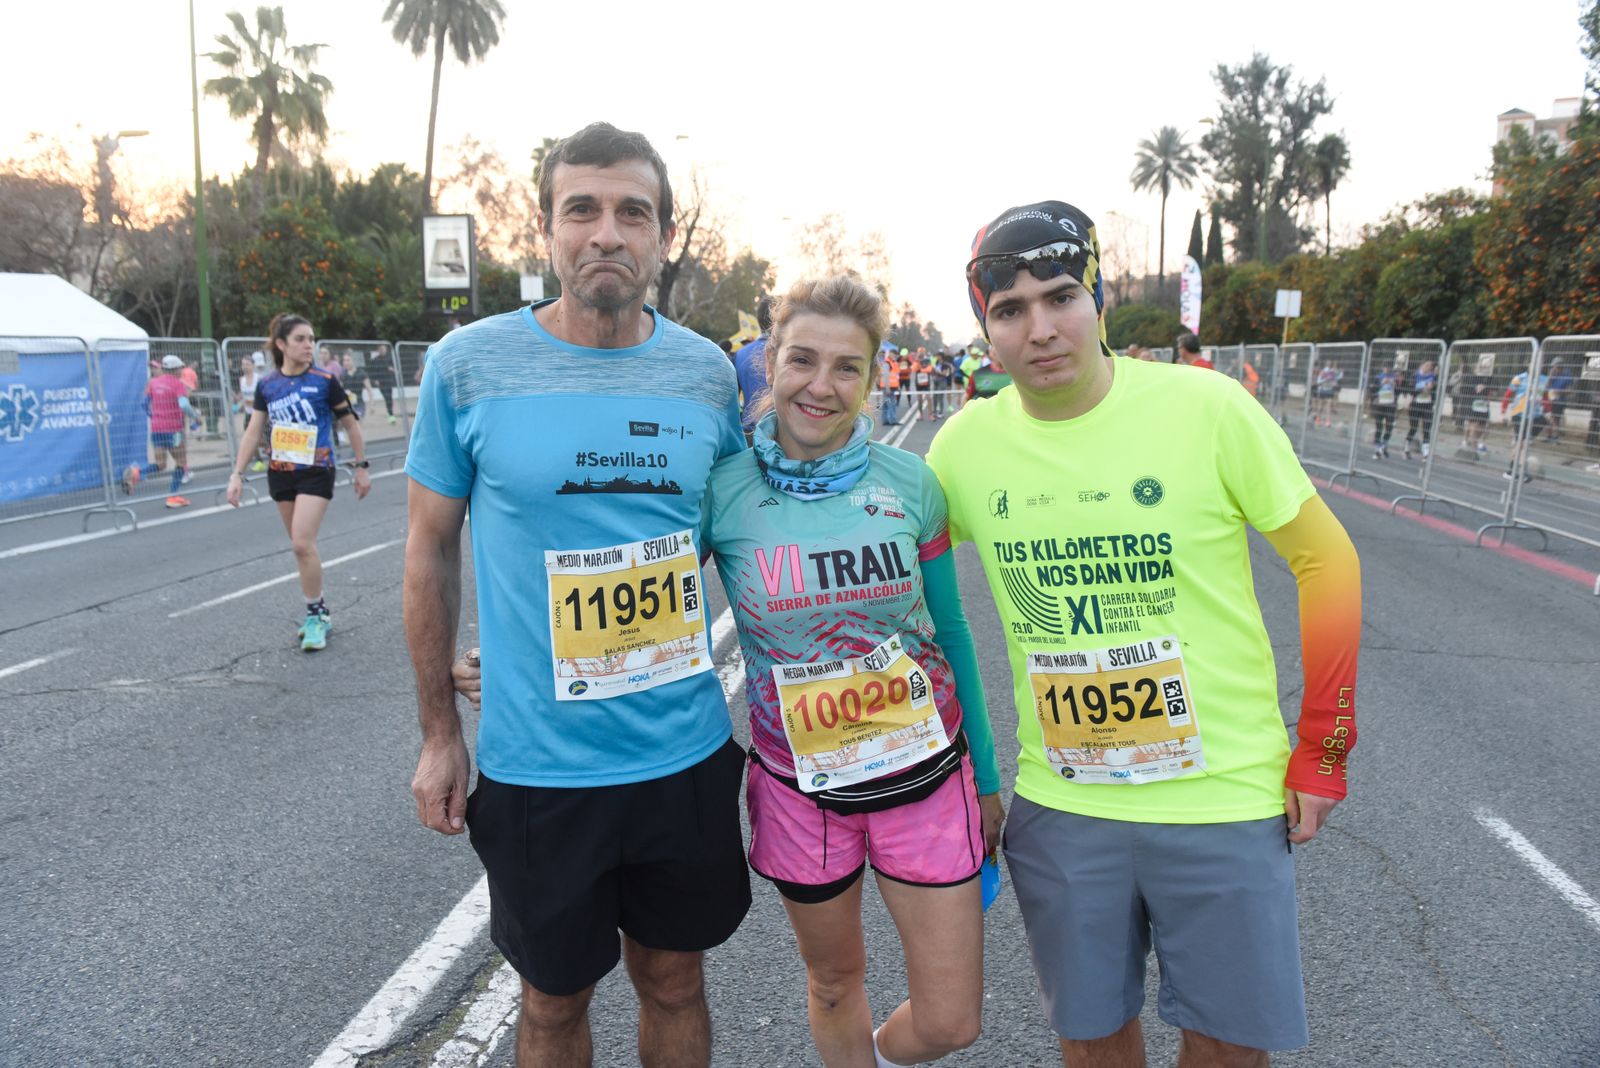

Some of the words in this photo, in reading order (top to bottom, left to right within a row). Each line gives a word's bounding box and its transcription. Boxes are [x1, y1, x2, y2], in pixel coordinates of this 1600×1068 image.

[43, 387, 88, 401] PUESTO
[41, 400, 108, 416] SANITARO
[575, 451, 668, 469] #Sevilla10
[849, 495, 867, 506] TOP
[556, 554, 581, 568] MEDIO
[583, 548, 623, 568] MARATÓN
[643, 535, 680, 561] SEVILLA
[994, 541, 1027, 563] TUS
[754, 543, 805, 597] VI
[808, 541, 912, 590] TRAIL
[1036, 563, 1078, 587] NOS
[1080, 562, 1122, 585] DAN
[1123, 559, 1174, 584] VIDA
[565, 571, 677, 631] 11951
[766, 597, 812, 614] SIERRA
[815, 593, 832, 607] DE
[835, 580, 913, 604] AZNALCÓLLAR
[867, 596, 901, 607] NOVIEMBRE
[1101, 592, 1137, 606] CARRERA
[1137, 587, 1177, 604] SOLIDARIA
[1064, 594, 1104, 635] XI
[1103, 606, 1135, 620] CONTRA
[1136, 605, 1145, 617] EL
[618, 626, 641, 637] Jesus
[1011, 622, 1033, 635] 29.10
[1105, 619, 1141, 634] INFANTIL
[604, 645, 626, 656] SALAS
[626, 638, 656, 651] SANCHEZ
[1034, 654, 1053, 668] MEDIO
[1054, 652, 1088, 668] MARATÓN
[1108, 641, 1158, 667] SEVILLA
[627, 672, 650, 685] HOKA
[783, 667, 806, 680] MEDIO
[793, 676, 909, 733] 10020
[1044, 677, 1164, 725] 11952
[1337, 686, 1353, 709] La
[1091, 726, 1117, 734] Alonso
[839, 736, 857, 747] TOUS
[1118, 739, 1137, 747] TOUS
[864, 759, 886, 772] HOKA
[1109, 769, 1132, 779] HOKA
